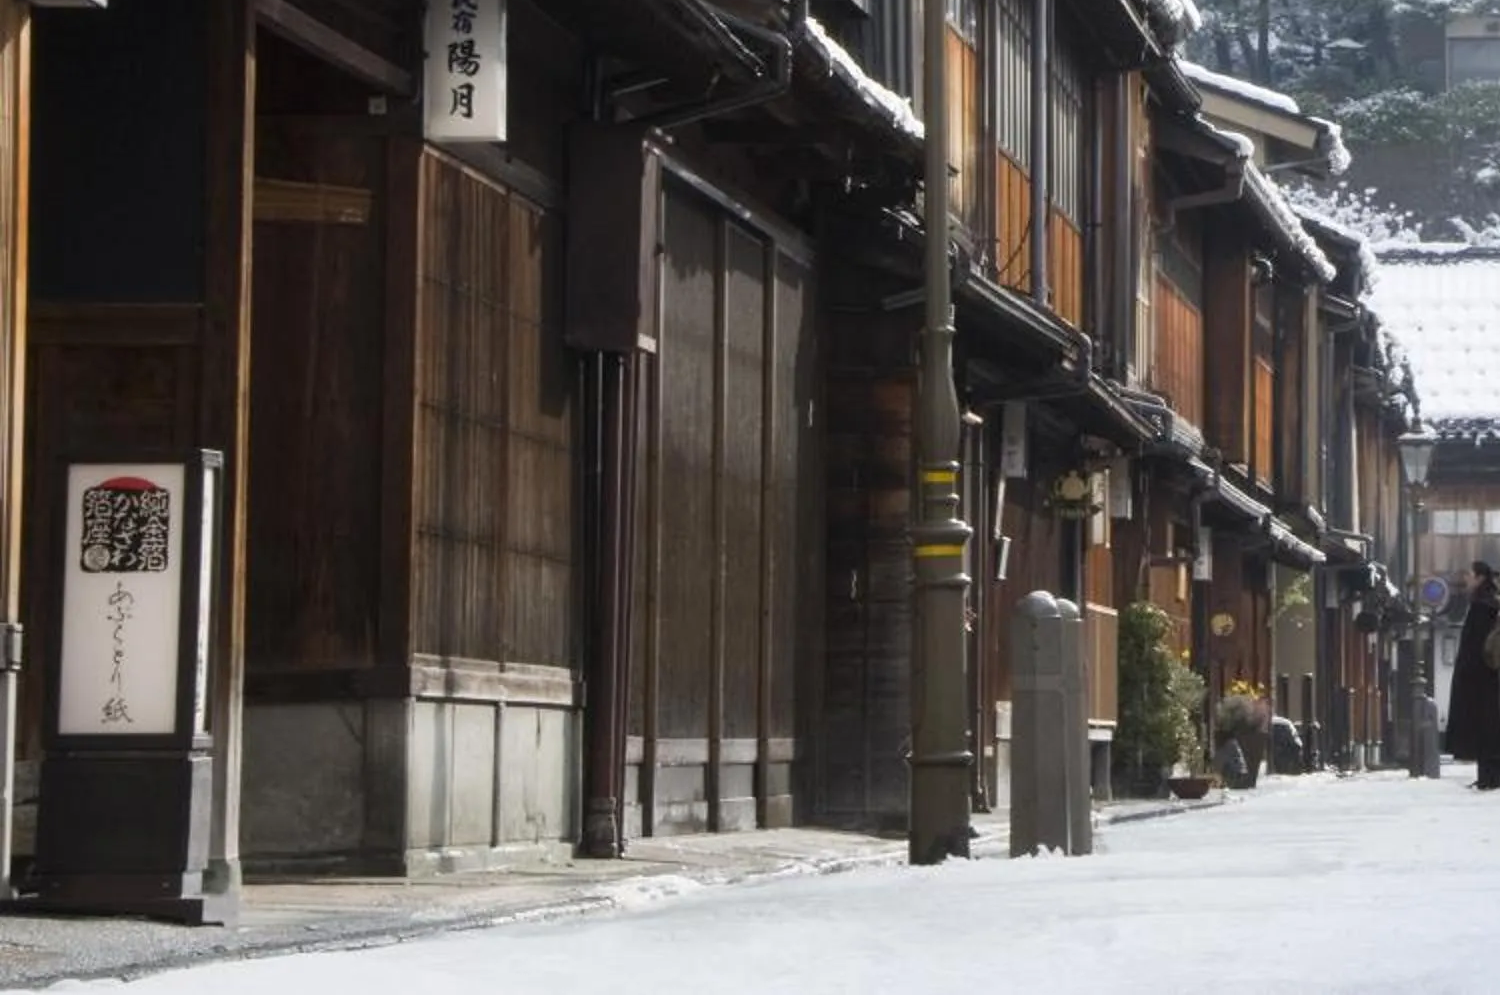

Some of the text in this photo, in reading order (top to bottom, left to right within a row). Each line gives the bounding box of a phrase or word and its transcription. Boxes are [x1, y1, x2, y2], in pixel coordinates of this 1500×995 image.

[111, 493, 138, 567] かなざわ
[138, 490, 168, 571] 純金箔
